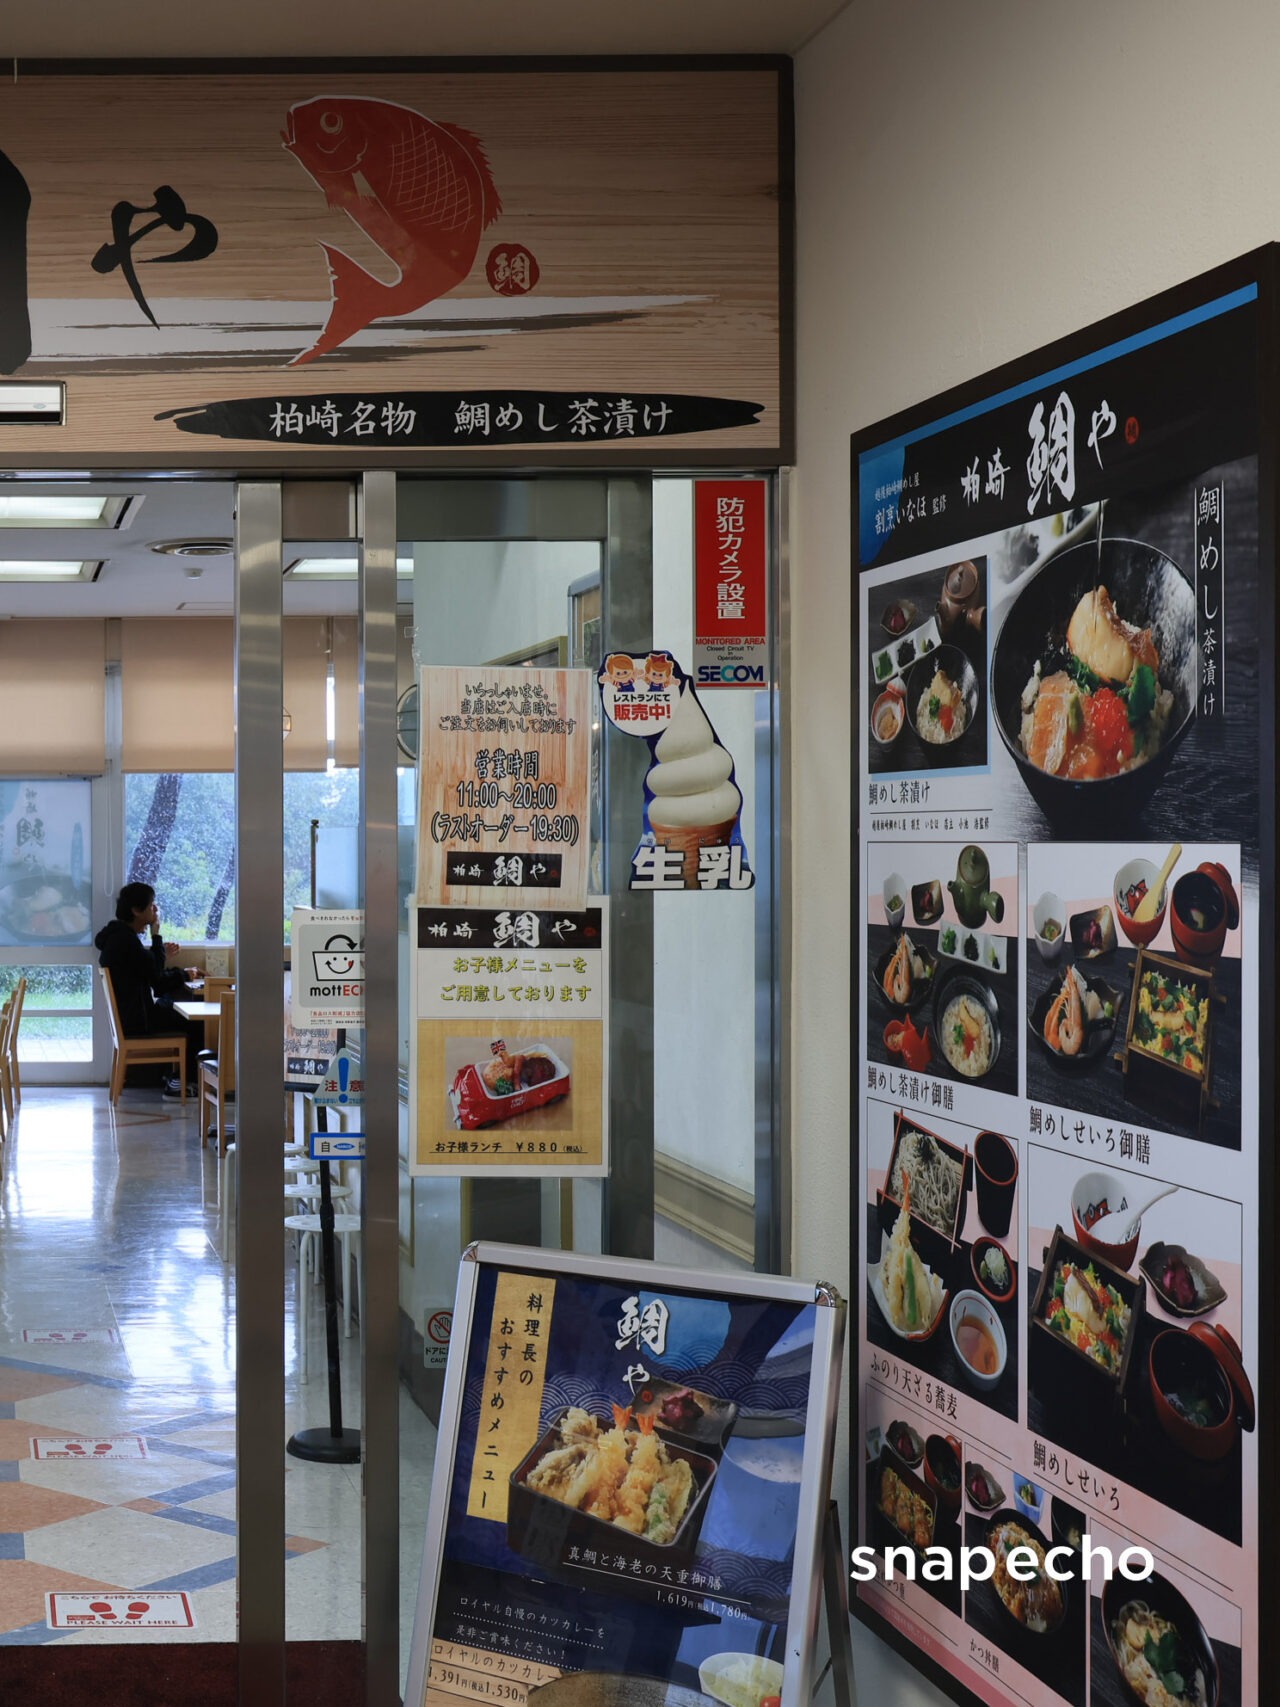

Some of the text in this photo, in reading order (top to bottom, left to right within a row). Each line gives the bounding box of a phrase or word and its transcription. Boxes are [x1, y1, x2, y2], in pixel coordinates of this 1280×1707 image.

[493, 251, 532, 291] 鯛
[269, 399, 674, 438] 柏崎名物 鯛めし茶漬け
[716, 497, 745, 619] 防犯カメラ設置
[1198, 485, 1222, 717] 鯛めし茶漬け
[465, 682, 549, 700] いらっしゃいませ。
[698, 665, 763, 682] SECOM
[460, 699, 557, 716] 当店はご入店時に
[613, 694, 670, 702] レストランにて
[614, 703, 671, 720] 販売中!
[438, 716, 577, 735] ご注文をお伺いしております
[475, 749, 539, 780] 営業時間
[869, 781, 930, 806] 鯛めし茶漬け
[631, 845, 753, 890] 生乳
[453, 957, 588, 974] お子様メニューを
[310, 985, 365, 997] mottEC
[440, 985, 592, 1002] ご用意しております
[867, 1065, 954, 1111] 鯛めし茶漬け御膳
[435, 1142, 502, 1152] お子様ランチ
[1029, 1105, 1151, 1165] 鯛めしせいろ御膳
[519, 1292, 544, 1386] 料理長の
[615, 1296, 669, 1397] 鯛や
[870, 1352, 958, 1420] ふのり天ざる蕎麦
[480, 1317, 513, 1509] おすすめメニュー
[1033, 1440, 1120, 1511] 鯛めしせいろ
[568, 1546, 723, 1591] 真鯛と海老の天重御膳
[460, 1597, 605, 1639] ロイヤル自慢のカツカレーを
[434, 1644, 563, 1681] ロイヤルのカツカレー
